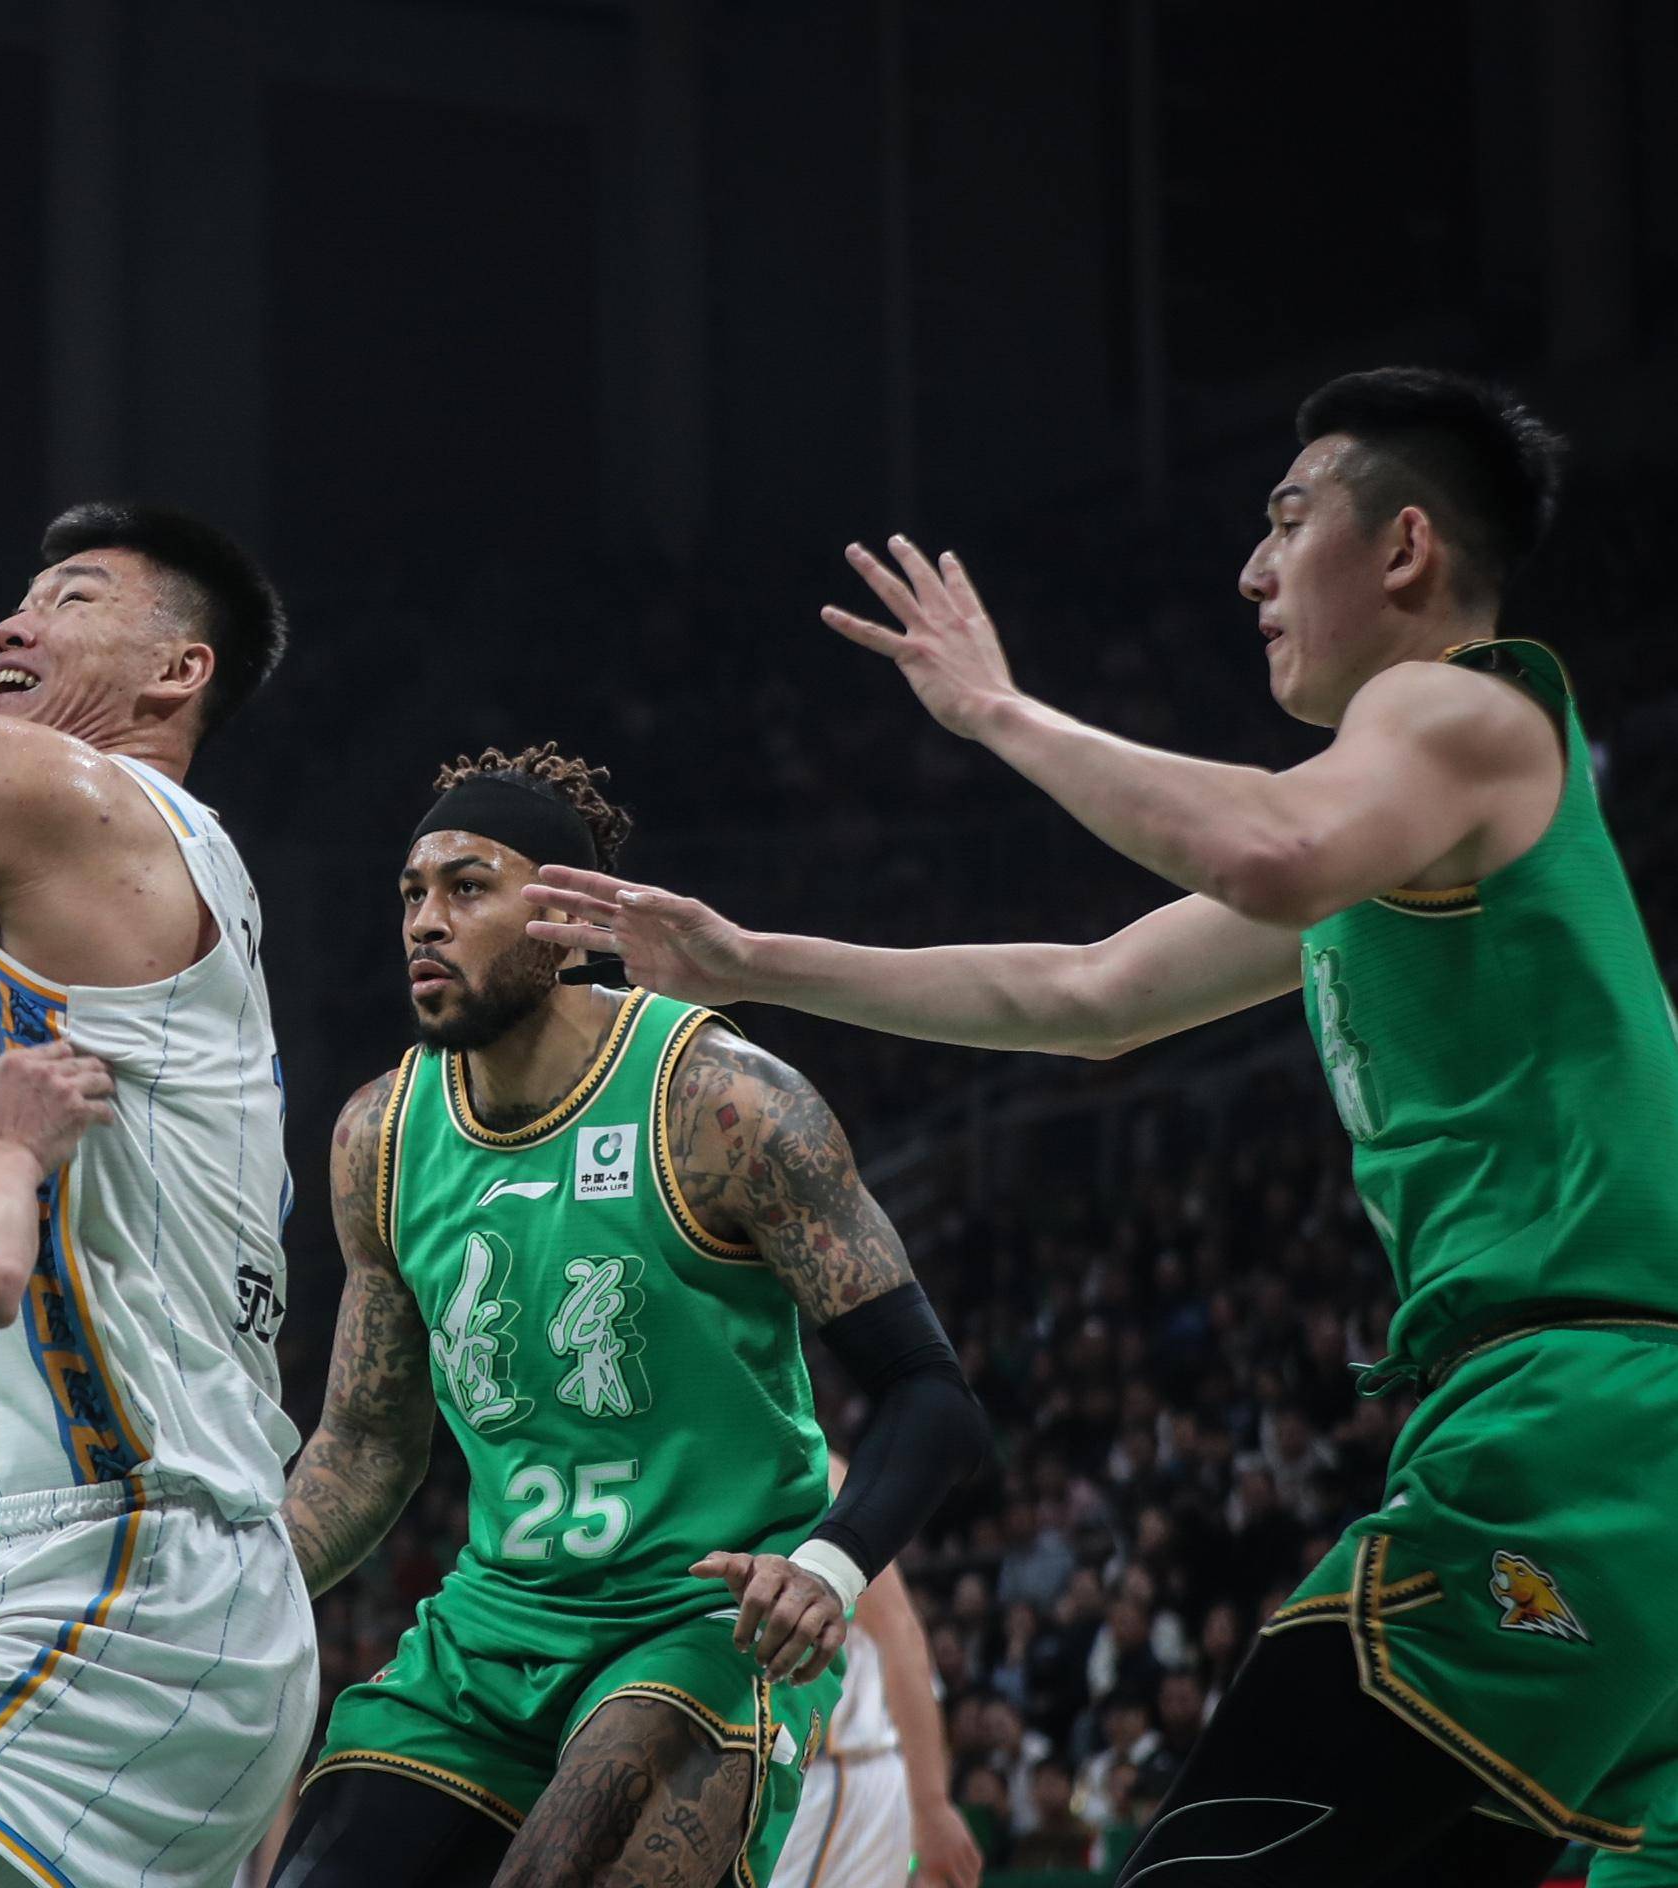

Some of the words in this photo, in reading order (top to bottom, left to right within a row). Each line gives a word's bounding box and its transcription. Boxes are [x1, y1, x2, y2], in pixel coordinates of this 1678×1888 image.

[581, 1170, 629, 1184] 中国人寿
[580, 1185, 608, 1193] CHINA
[609, 1183, 628, 1191] LIFE
[500, 1459, 639, 1561] 25
